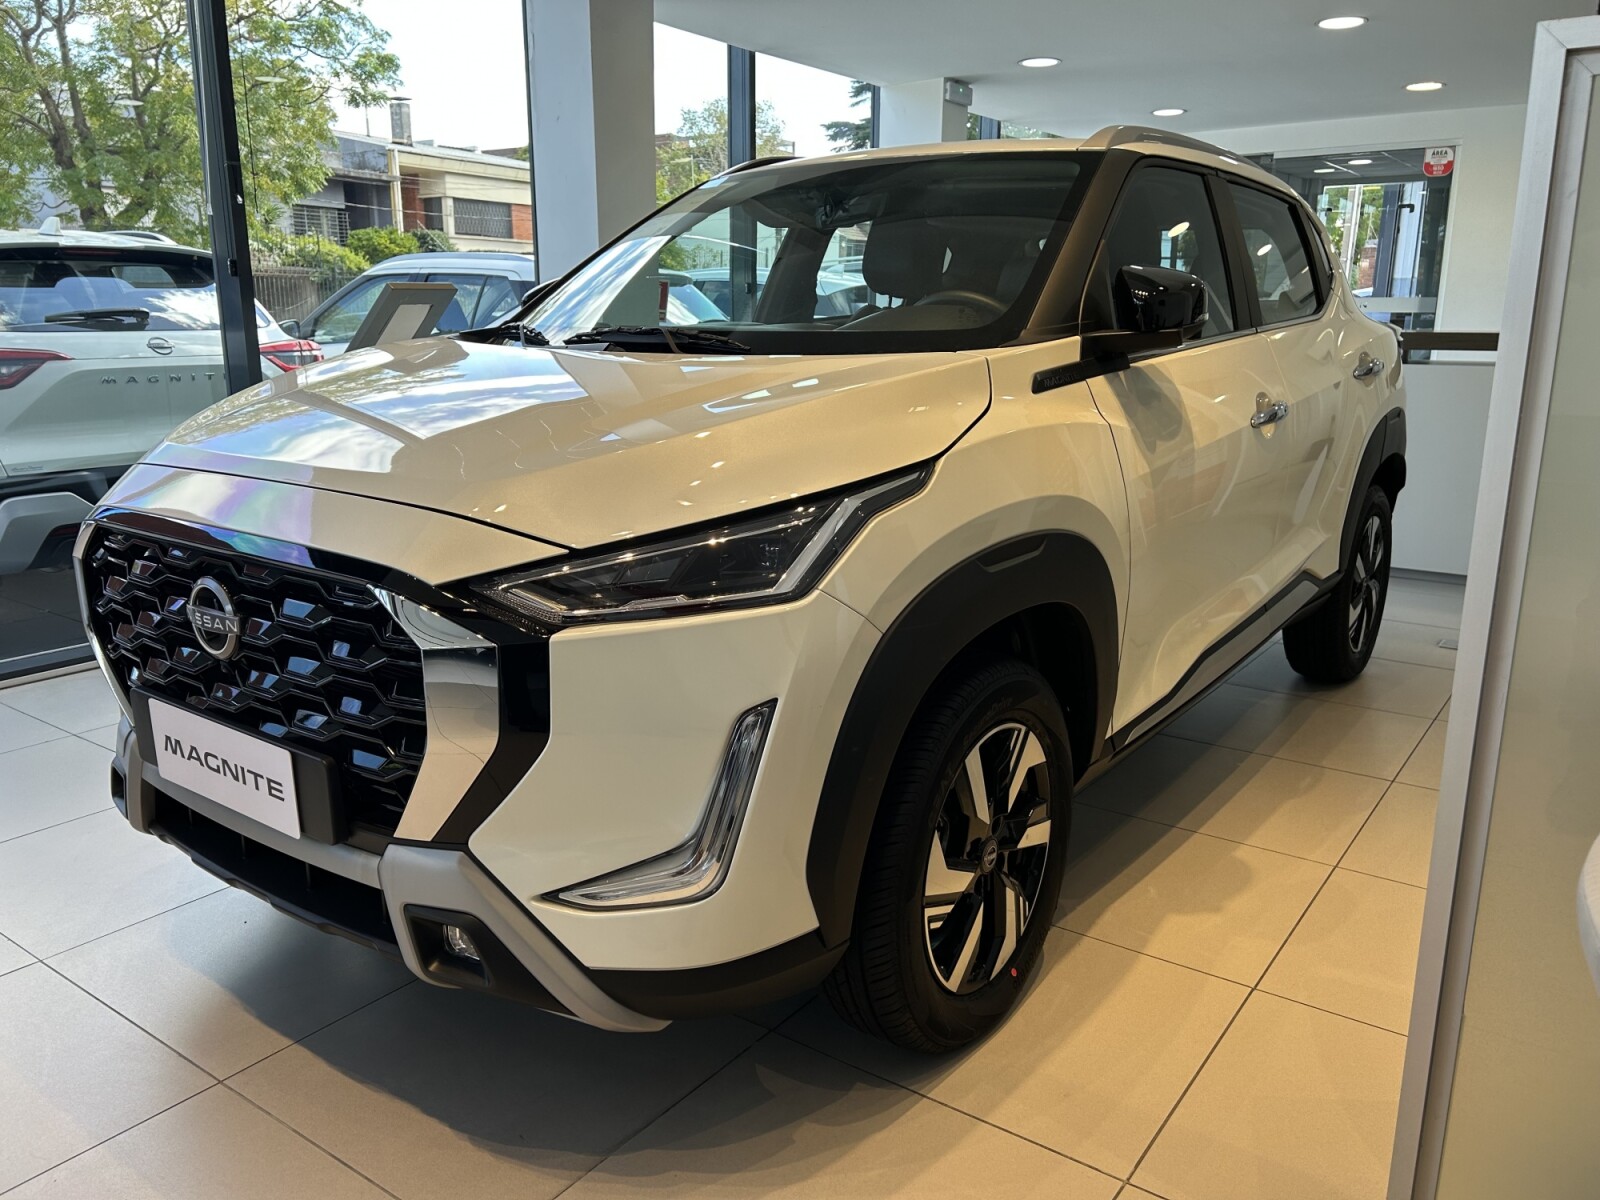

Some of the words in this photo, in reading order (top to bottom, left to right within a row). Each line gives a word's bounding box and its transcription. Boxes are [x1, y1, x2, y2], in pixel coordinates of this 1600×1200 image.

[101, 372, 226, 384] MAGNIT
[194, 612, 238, 632] SSAN
[164, 734, 285, 802] MAGNITE
